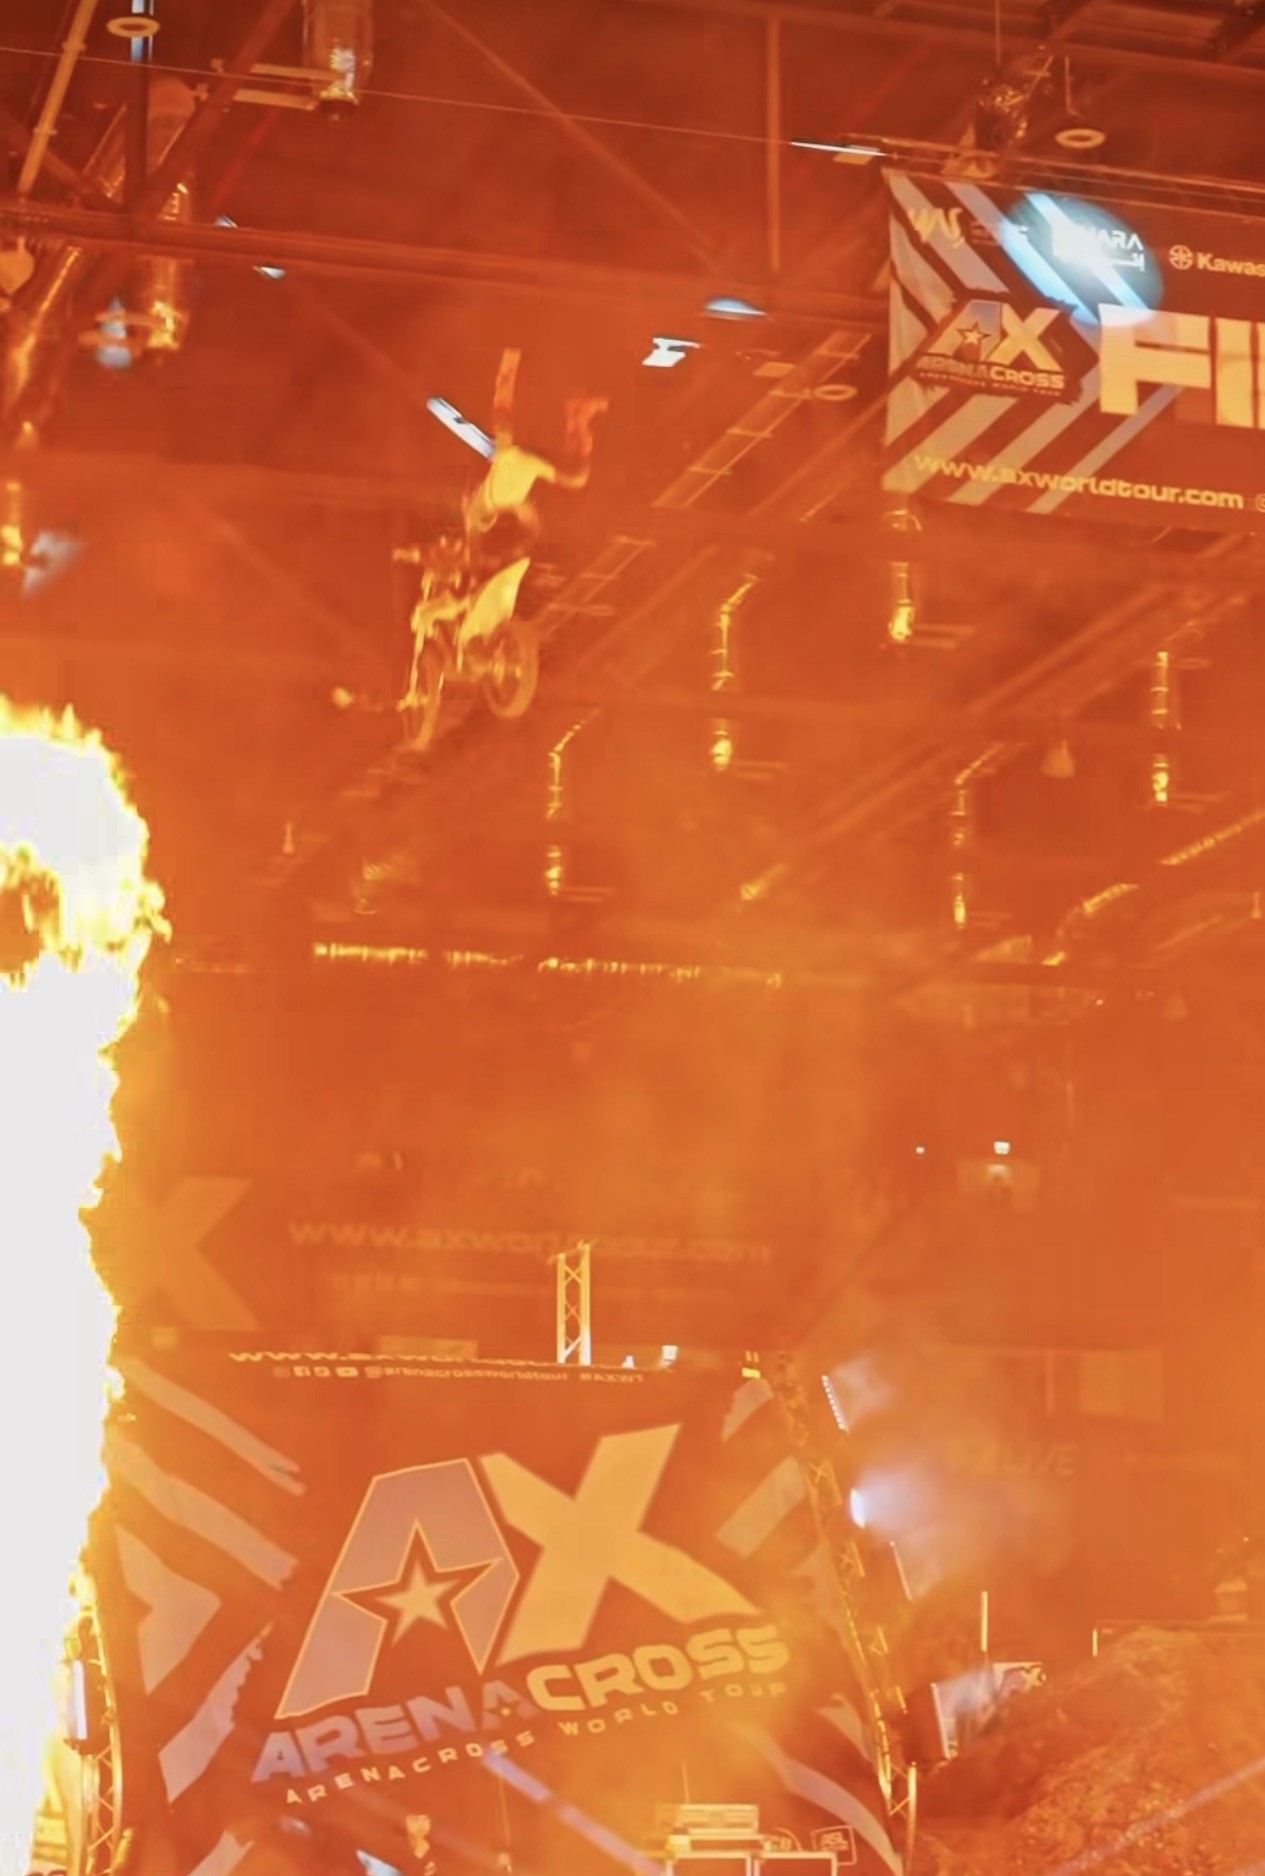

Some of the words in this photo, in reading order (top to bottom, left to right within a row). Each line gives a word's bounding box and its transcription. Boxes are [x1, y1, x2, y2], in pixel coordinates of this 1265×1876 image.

[1098, 303, 1265, 430] FI
[915, 454, 1244, 509] www.axworldtour.com
[275, 1422, 765, 1719] AX
[251, 1625, 791, 1782] ARENACROSS
[285, 1729, 536, 1805] ARENACROSS
[559, 1699, 679, 1738] WORLD
[701, 1680, 789, 1704] TOUR
